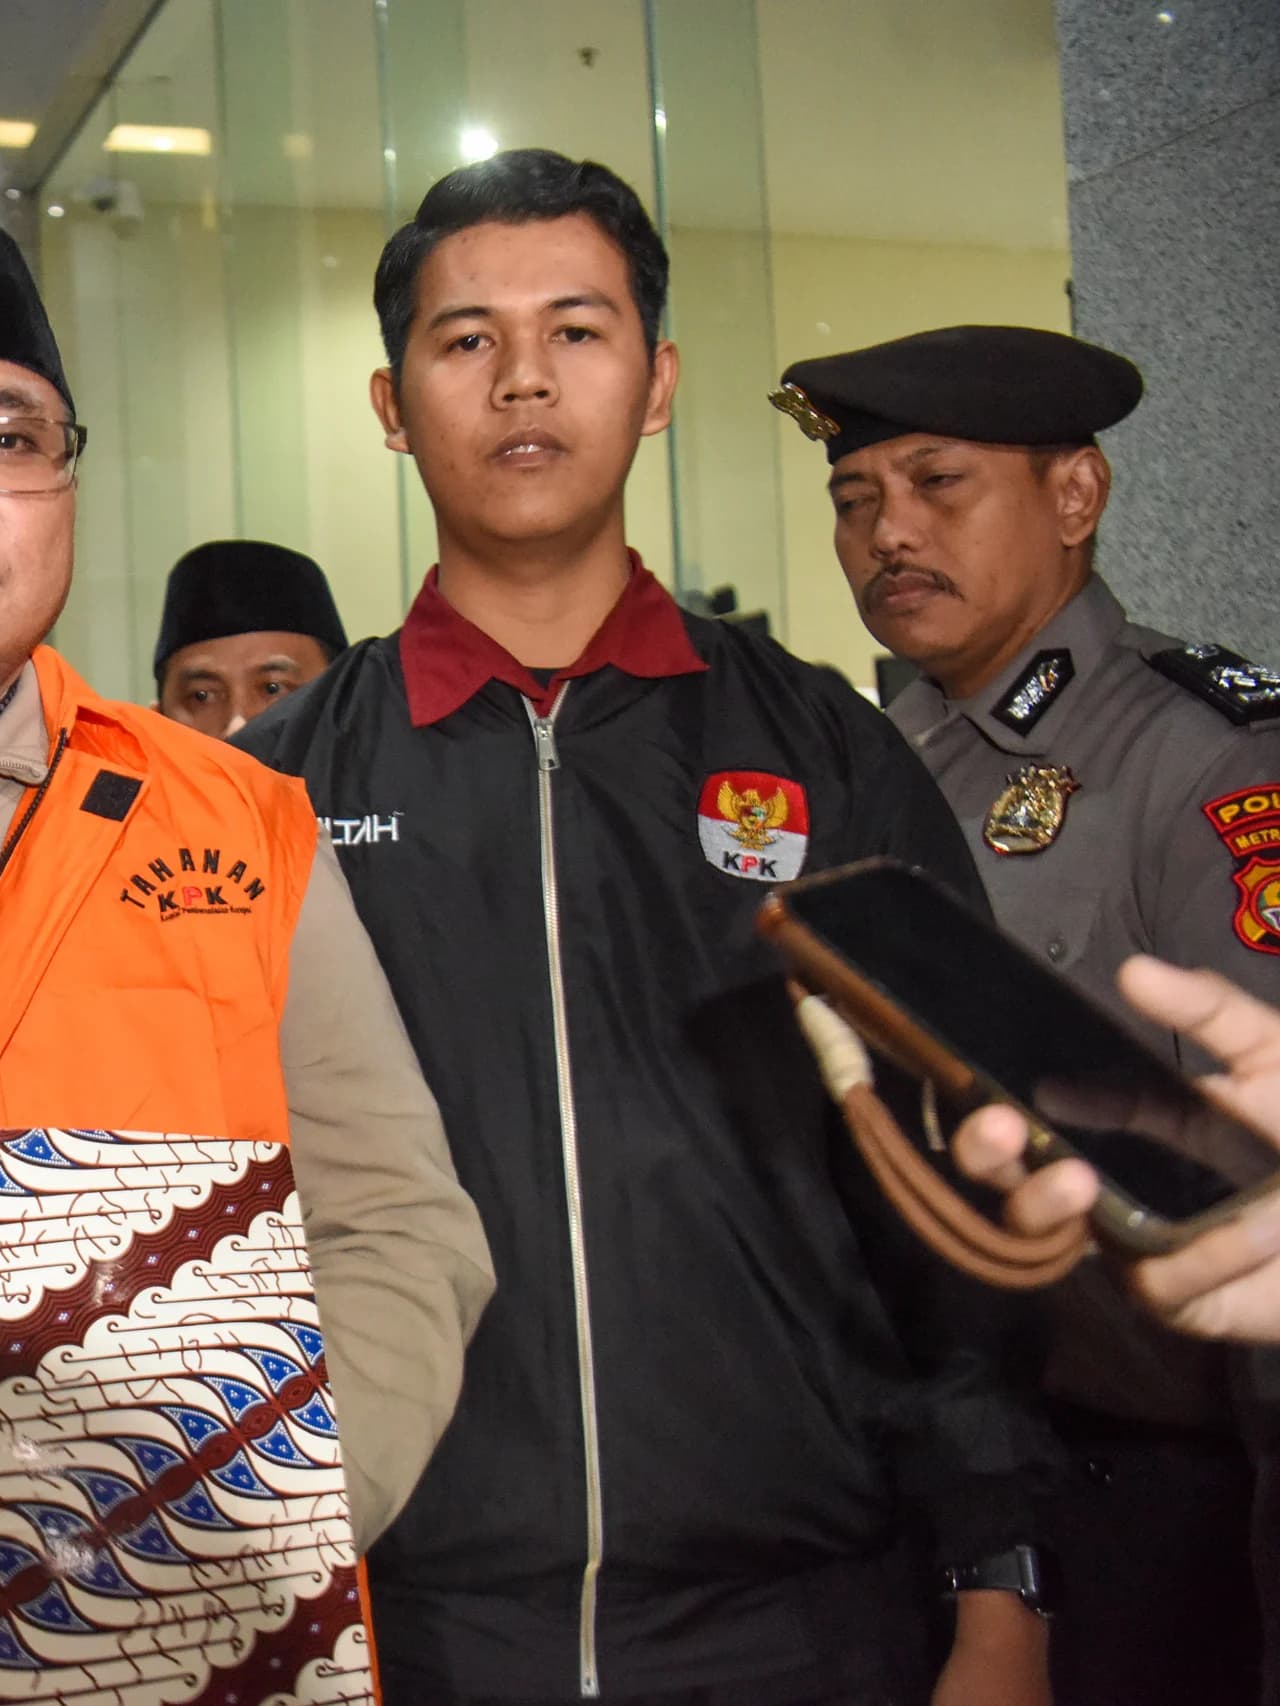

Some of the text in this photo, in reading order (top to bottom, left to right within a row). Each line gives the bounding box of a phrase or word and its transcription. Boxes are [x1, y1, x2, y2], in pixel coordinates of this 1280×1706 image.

[723, 851, 778, 878] KPK
[121, 848, 265, 909] TAHANAN
[158, 886, 228, 912] KPK
